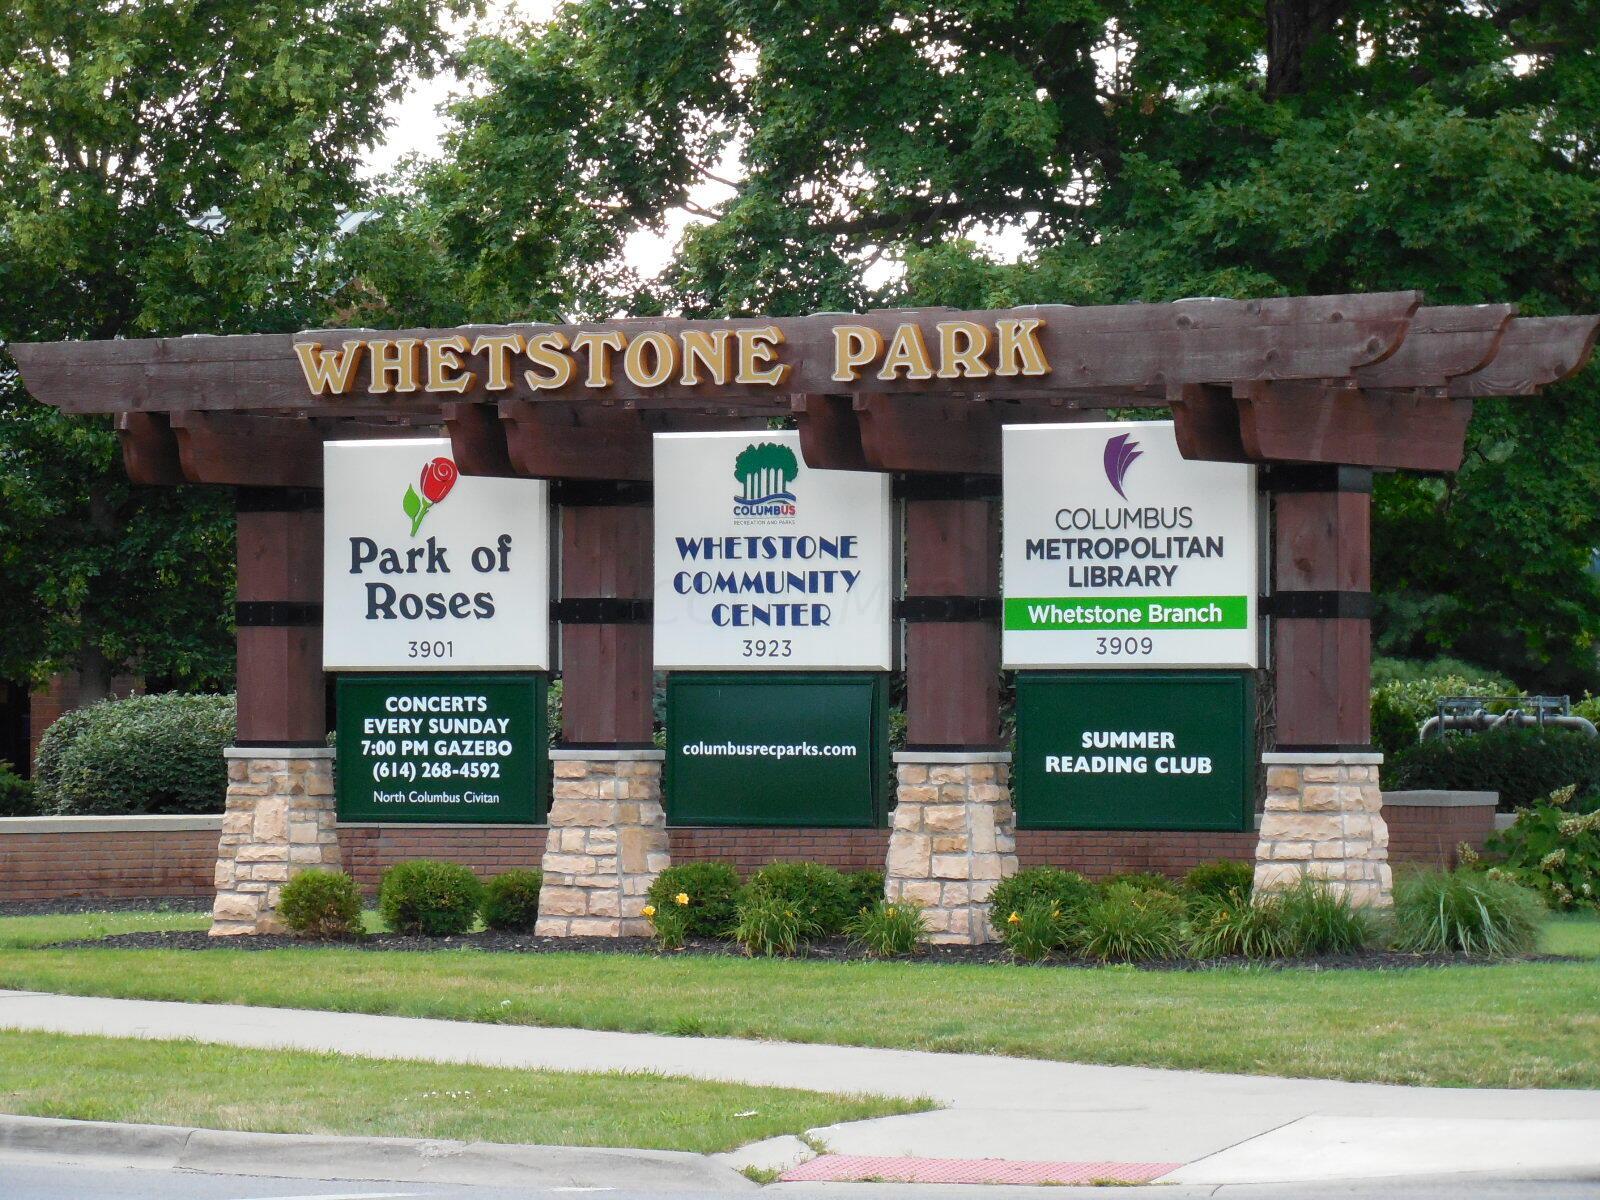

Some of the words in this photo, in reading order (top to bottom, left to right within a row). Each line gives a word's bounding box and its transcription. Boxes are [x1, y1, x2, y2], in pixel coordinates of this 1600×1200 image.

[292, 326, 788, 396] WHETSTONE
[832, 316, 1052, 383] PARK
[733, 506, 796, 516] COLUMBUS
[1055, 506, 1193, 531] COLUMBUS
[348, 535, 451, 575] Park
[471, 533, 513, 573] of
[674, 535, 858, 562] WHETSTONE
[1025, 535, 1224, 561] METROPOLITAN
[673, 569, 861, 595] COMMUNITY
[1068, 564, 1178, 588] LIBRARY
[364, 582, 496, 621] Roses
[711, 603, 831, 627] CENTER
[1027, 604, 1142, 624] Whetstone
[1148, 602, 1223, 623] Branch
[408, 640, 453, 659] 3901
[742, 639, 792, 658] 3923
[1095, 636, 1153, 656] 3909
[385, 696, 488, 713] CONCERTS
[364, 718, 424, 734] EVERY
[428, 718, 510, 734] SUNDAY
[361, 740, 397, 756] 7:00
[401, 740, 429, 756] PM
[433, 740, 513, 757] GAZEBO
[682, 740, 857, 760] columbusrecparks.com
[1081, 731, 1176, 749] SUMMER
[372, 761, 417, 783] (614)
[421, 761, 501, 779] 268-4592
[1045, 755, 1148, 774] READING
[1154, 756, 1213, 774] CLUB
[373, 790, 406, 803] North
[408, 790, 461, 803] Columbus
[463, 790, 500, 804] Civitan
